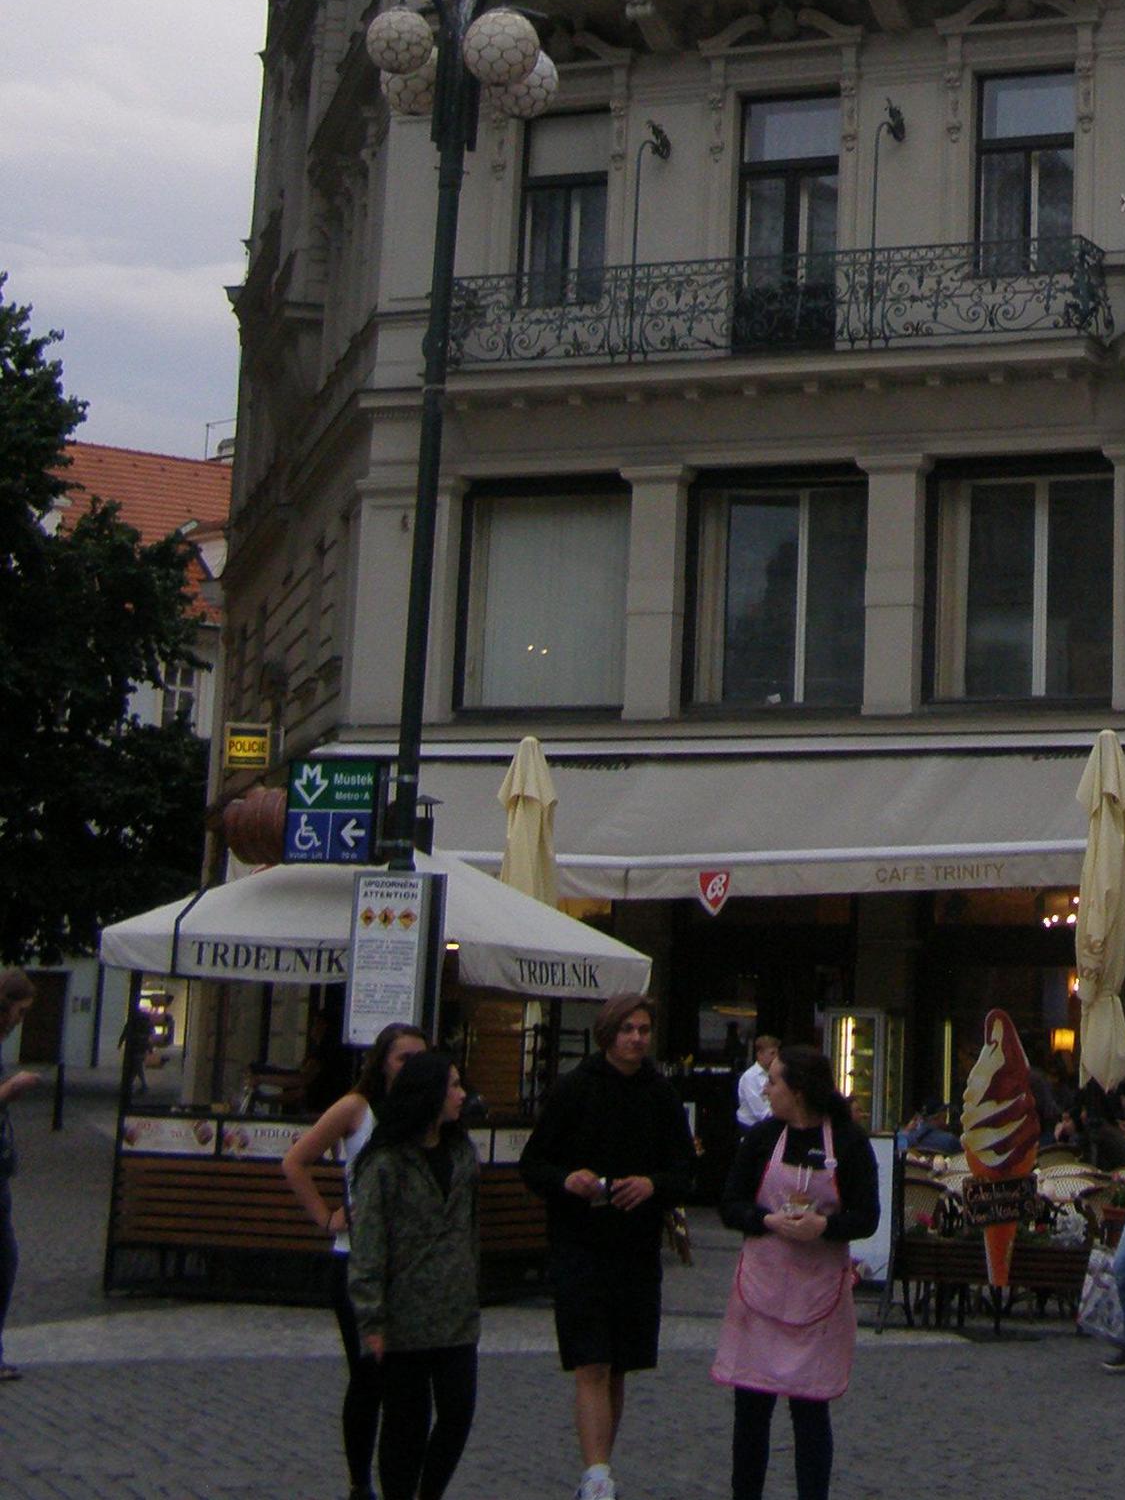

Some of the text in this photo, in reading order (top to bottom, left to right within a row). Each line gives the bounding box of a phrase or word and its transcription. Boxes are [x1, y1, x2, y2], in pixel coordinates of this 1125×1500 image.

[228, 740, 268, 753] POLICIE
[931, 862, 1006, 882] TRINITY
[363, 890, 418, 900] ATTENTION
[191, 939, 348, 973] TRDELNÍK
[515, 957, 600, 989] TRDELNÍK
